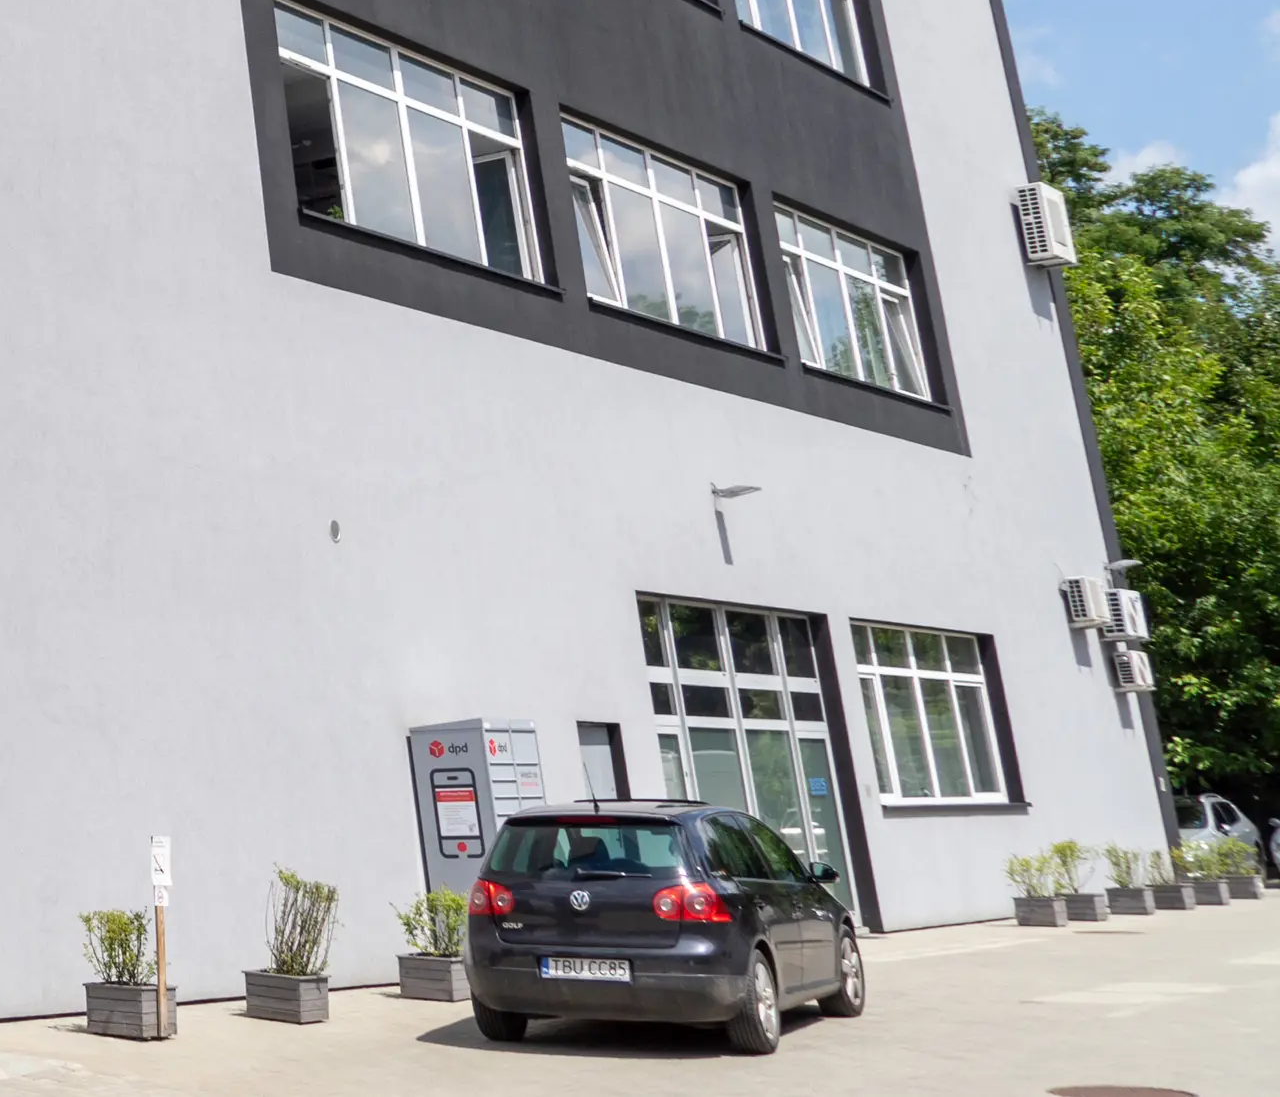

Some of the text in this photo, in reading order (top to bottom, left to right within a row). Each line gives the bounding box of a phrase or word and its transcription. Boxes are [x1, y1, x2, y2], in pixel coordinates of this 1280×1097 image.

[448, 743, 468, 755] dpd
[552, 959, 627, 977] TBU CC85
